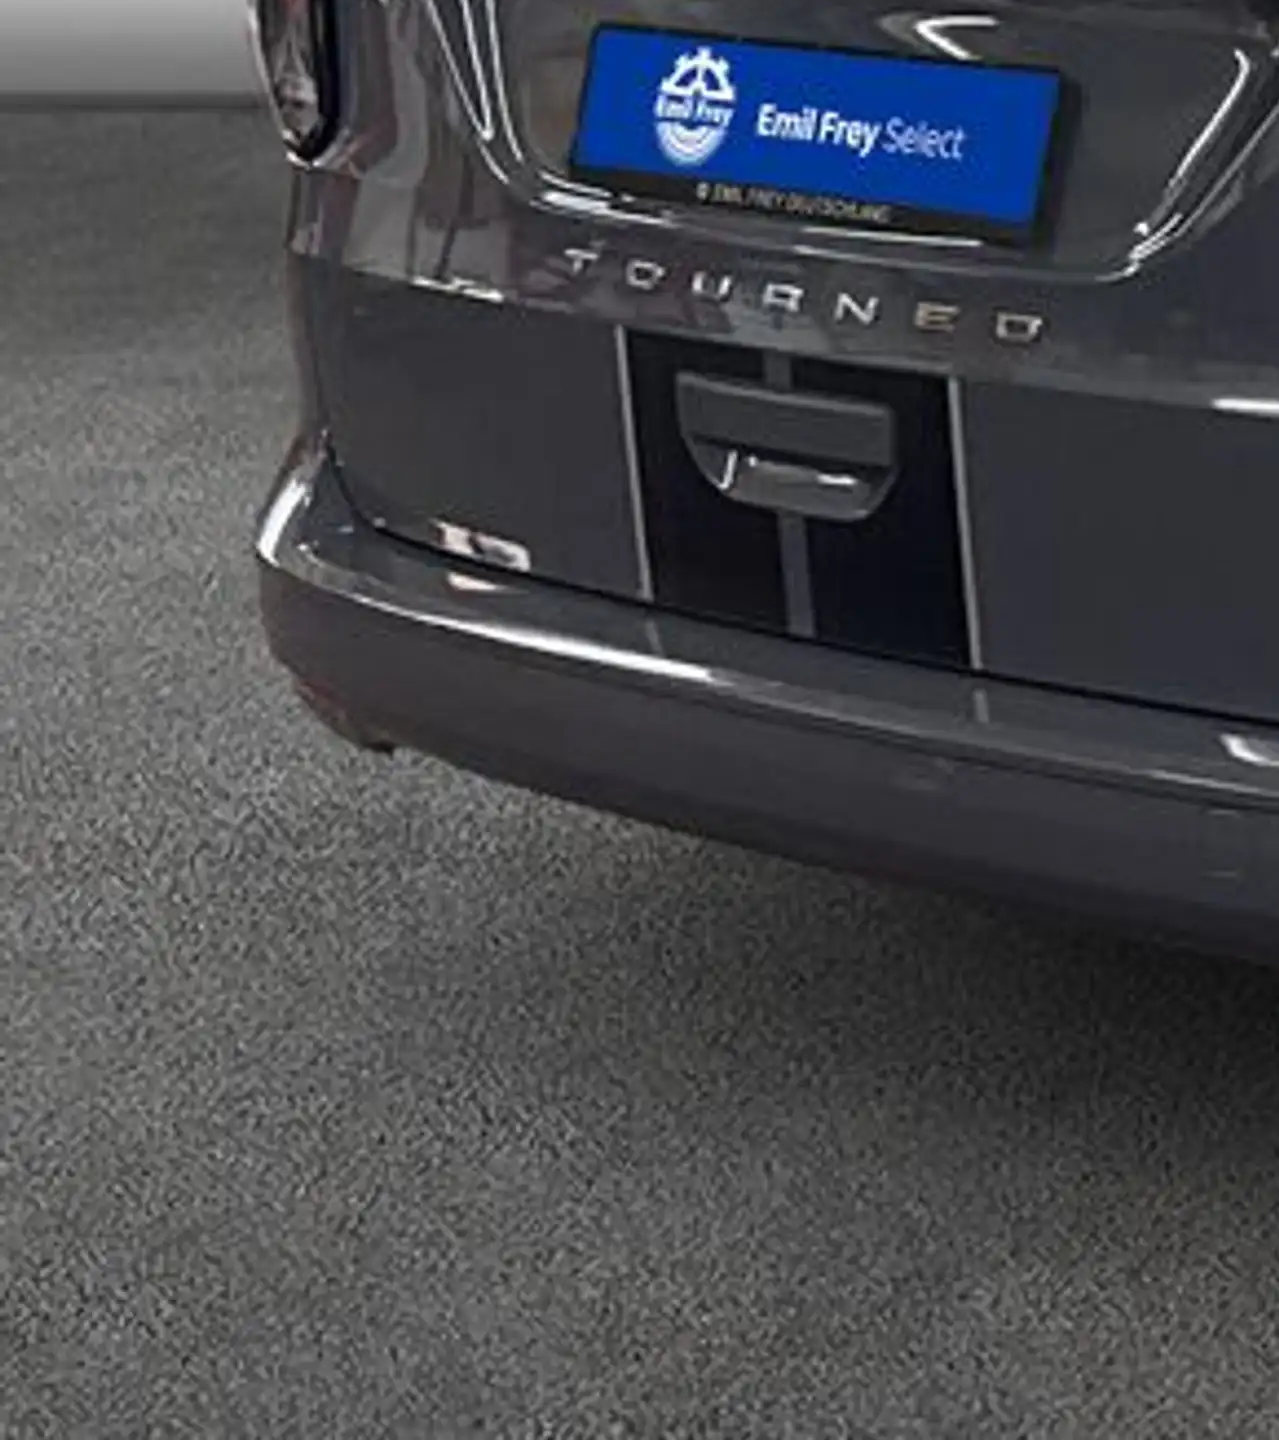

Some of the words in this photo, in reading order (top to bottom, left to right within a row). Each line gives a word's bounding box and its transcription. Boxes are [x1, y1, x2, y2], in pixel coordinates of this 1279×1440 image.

[757, 103, 817, 141] Emil
[817, 110, 882, 158] Frey
[881, 116, 966, 160] Select
[564, 246, 1045, 343] TOURNEO
